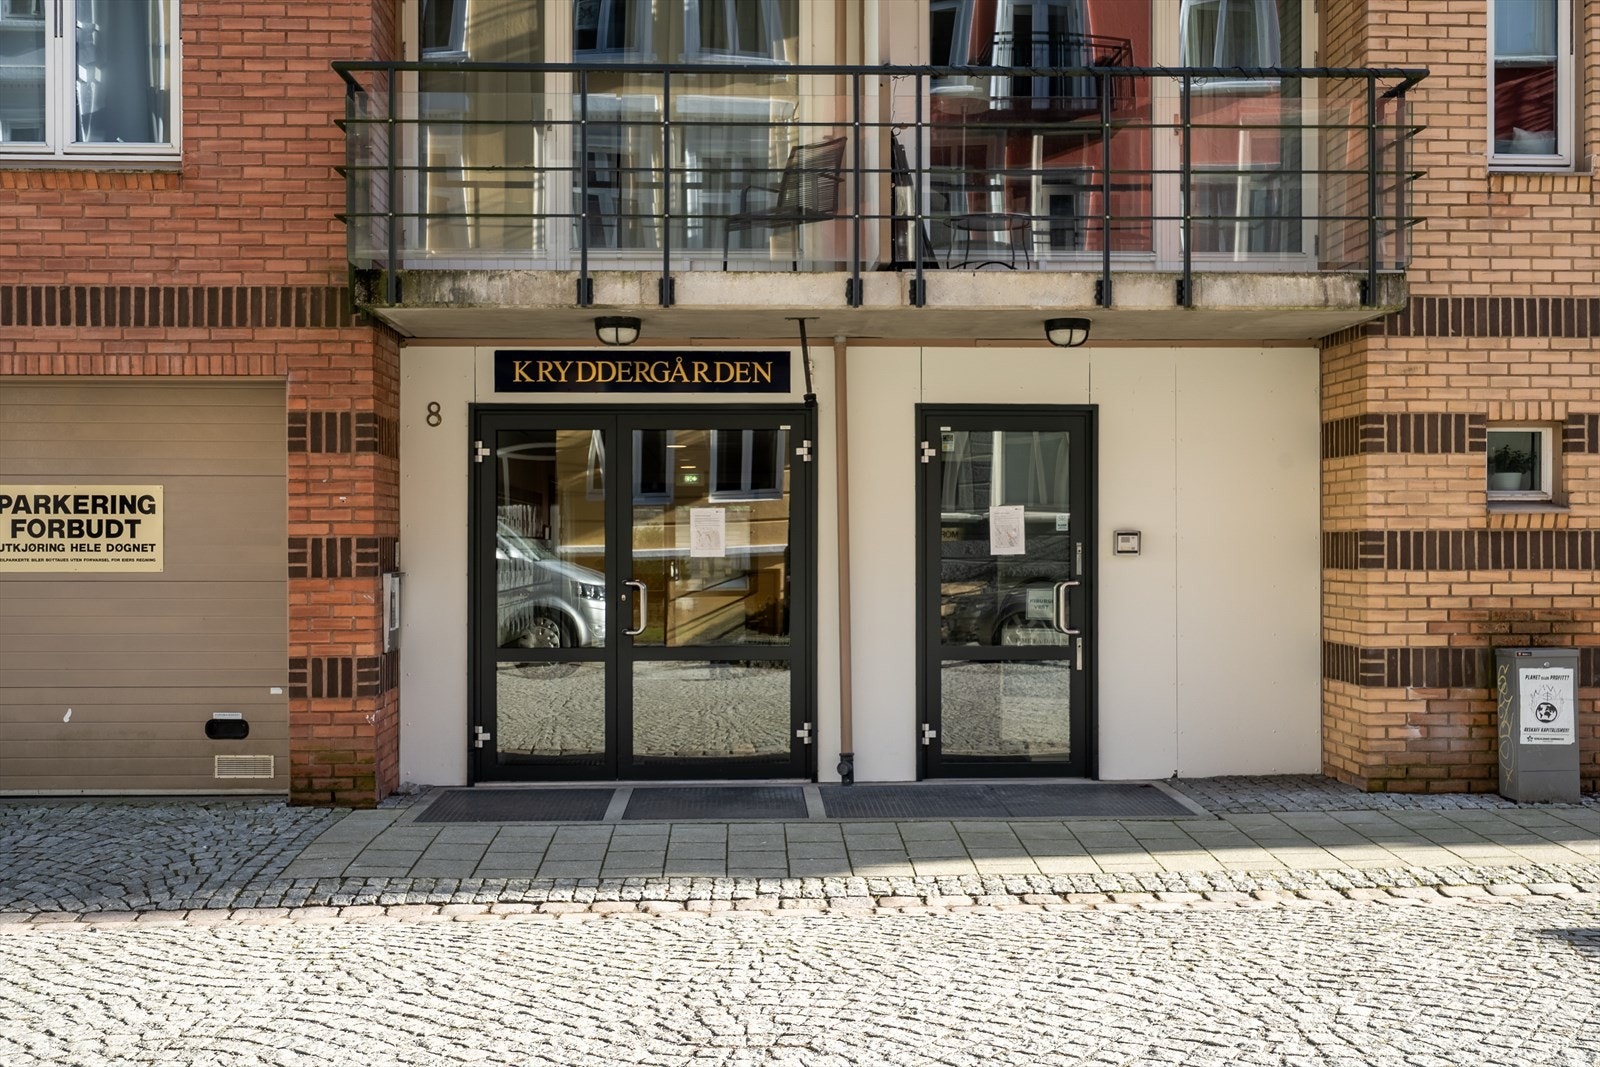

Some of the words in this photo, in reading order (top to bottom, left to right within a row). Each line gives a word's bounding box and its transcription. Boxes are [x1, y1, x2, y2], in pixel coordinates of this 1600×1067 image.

[512, 356, 774, 384] KRYDDERGÅRDEN
[426, 402, 441, 426] 8
[0, 494, 156, 515] PARKERING
[11, 518, 142, 539] FORBUDT
[70, 543, 102, 553] HELE
[106, 543, 157, 553] DØGNET
